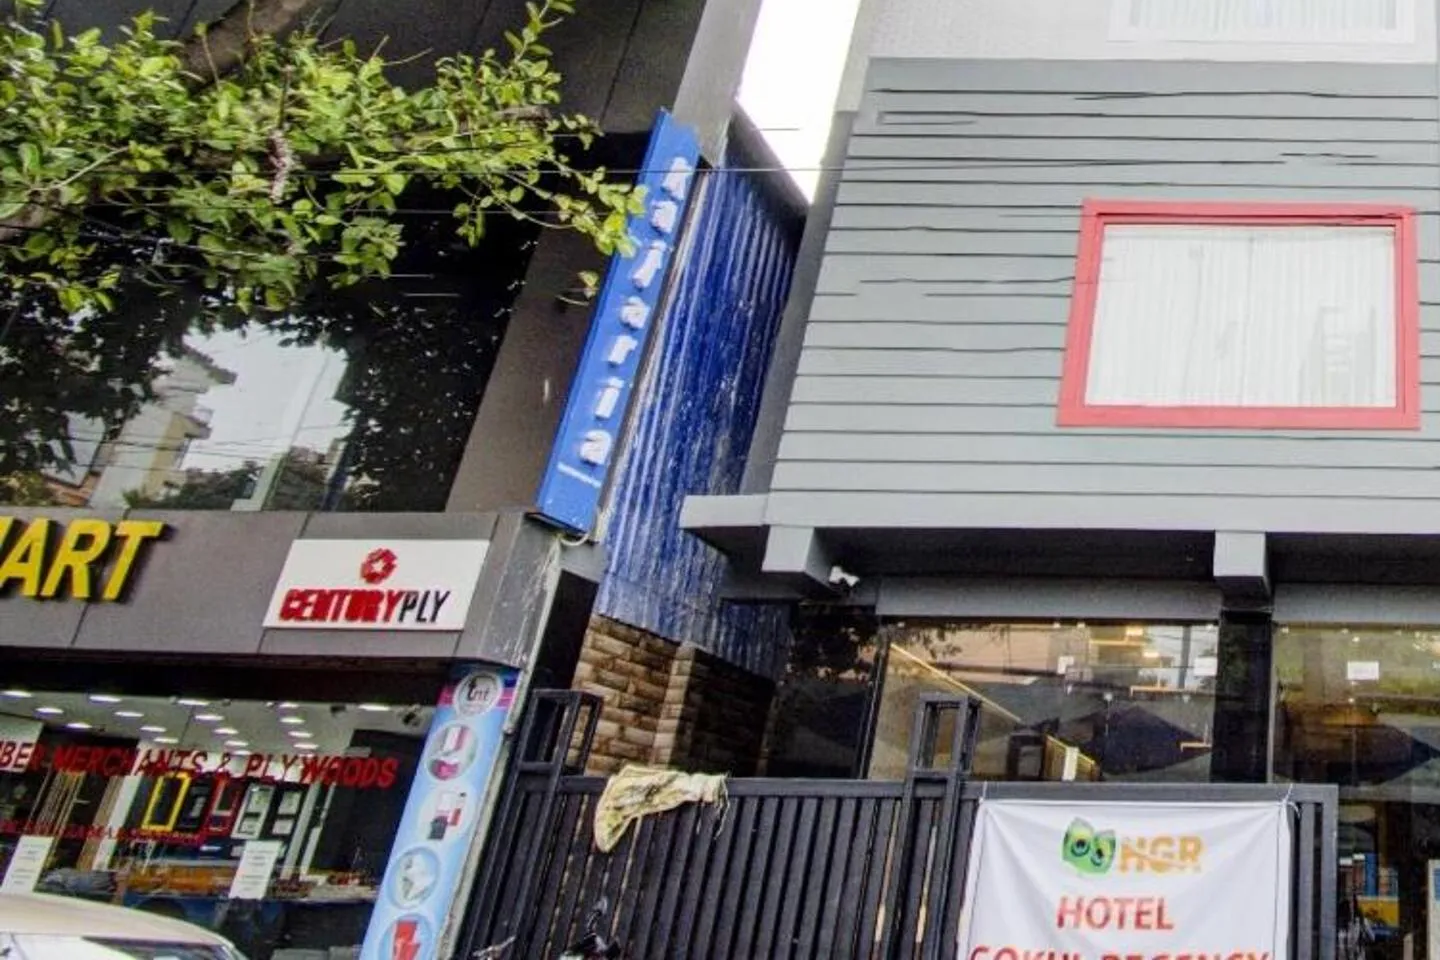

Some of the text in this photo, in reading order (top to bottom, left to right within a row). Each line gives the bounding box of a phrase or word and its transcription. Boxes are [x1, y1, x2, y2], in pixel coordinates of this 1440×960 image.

[0, 515, 164, 600] ART
[279, 589, 450, 622] CENTURYPLY
[0, 741, 45, 772] BER
[52, 744, 207, 778] MERCHANTS
[1056, 896, 1174, 930] HOTEL
